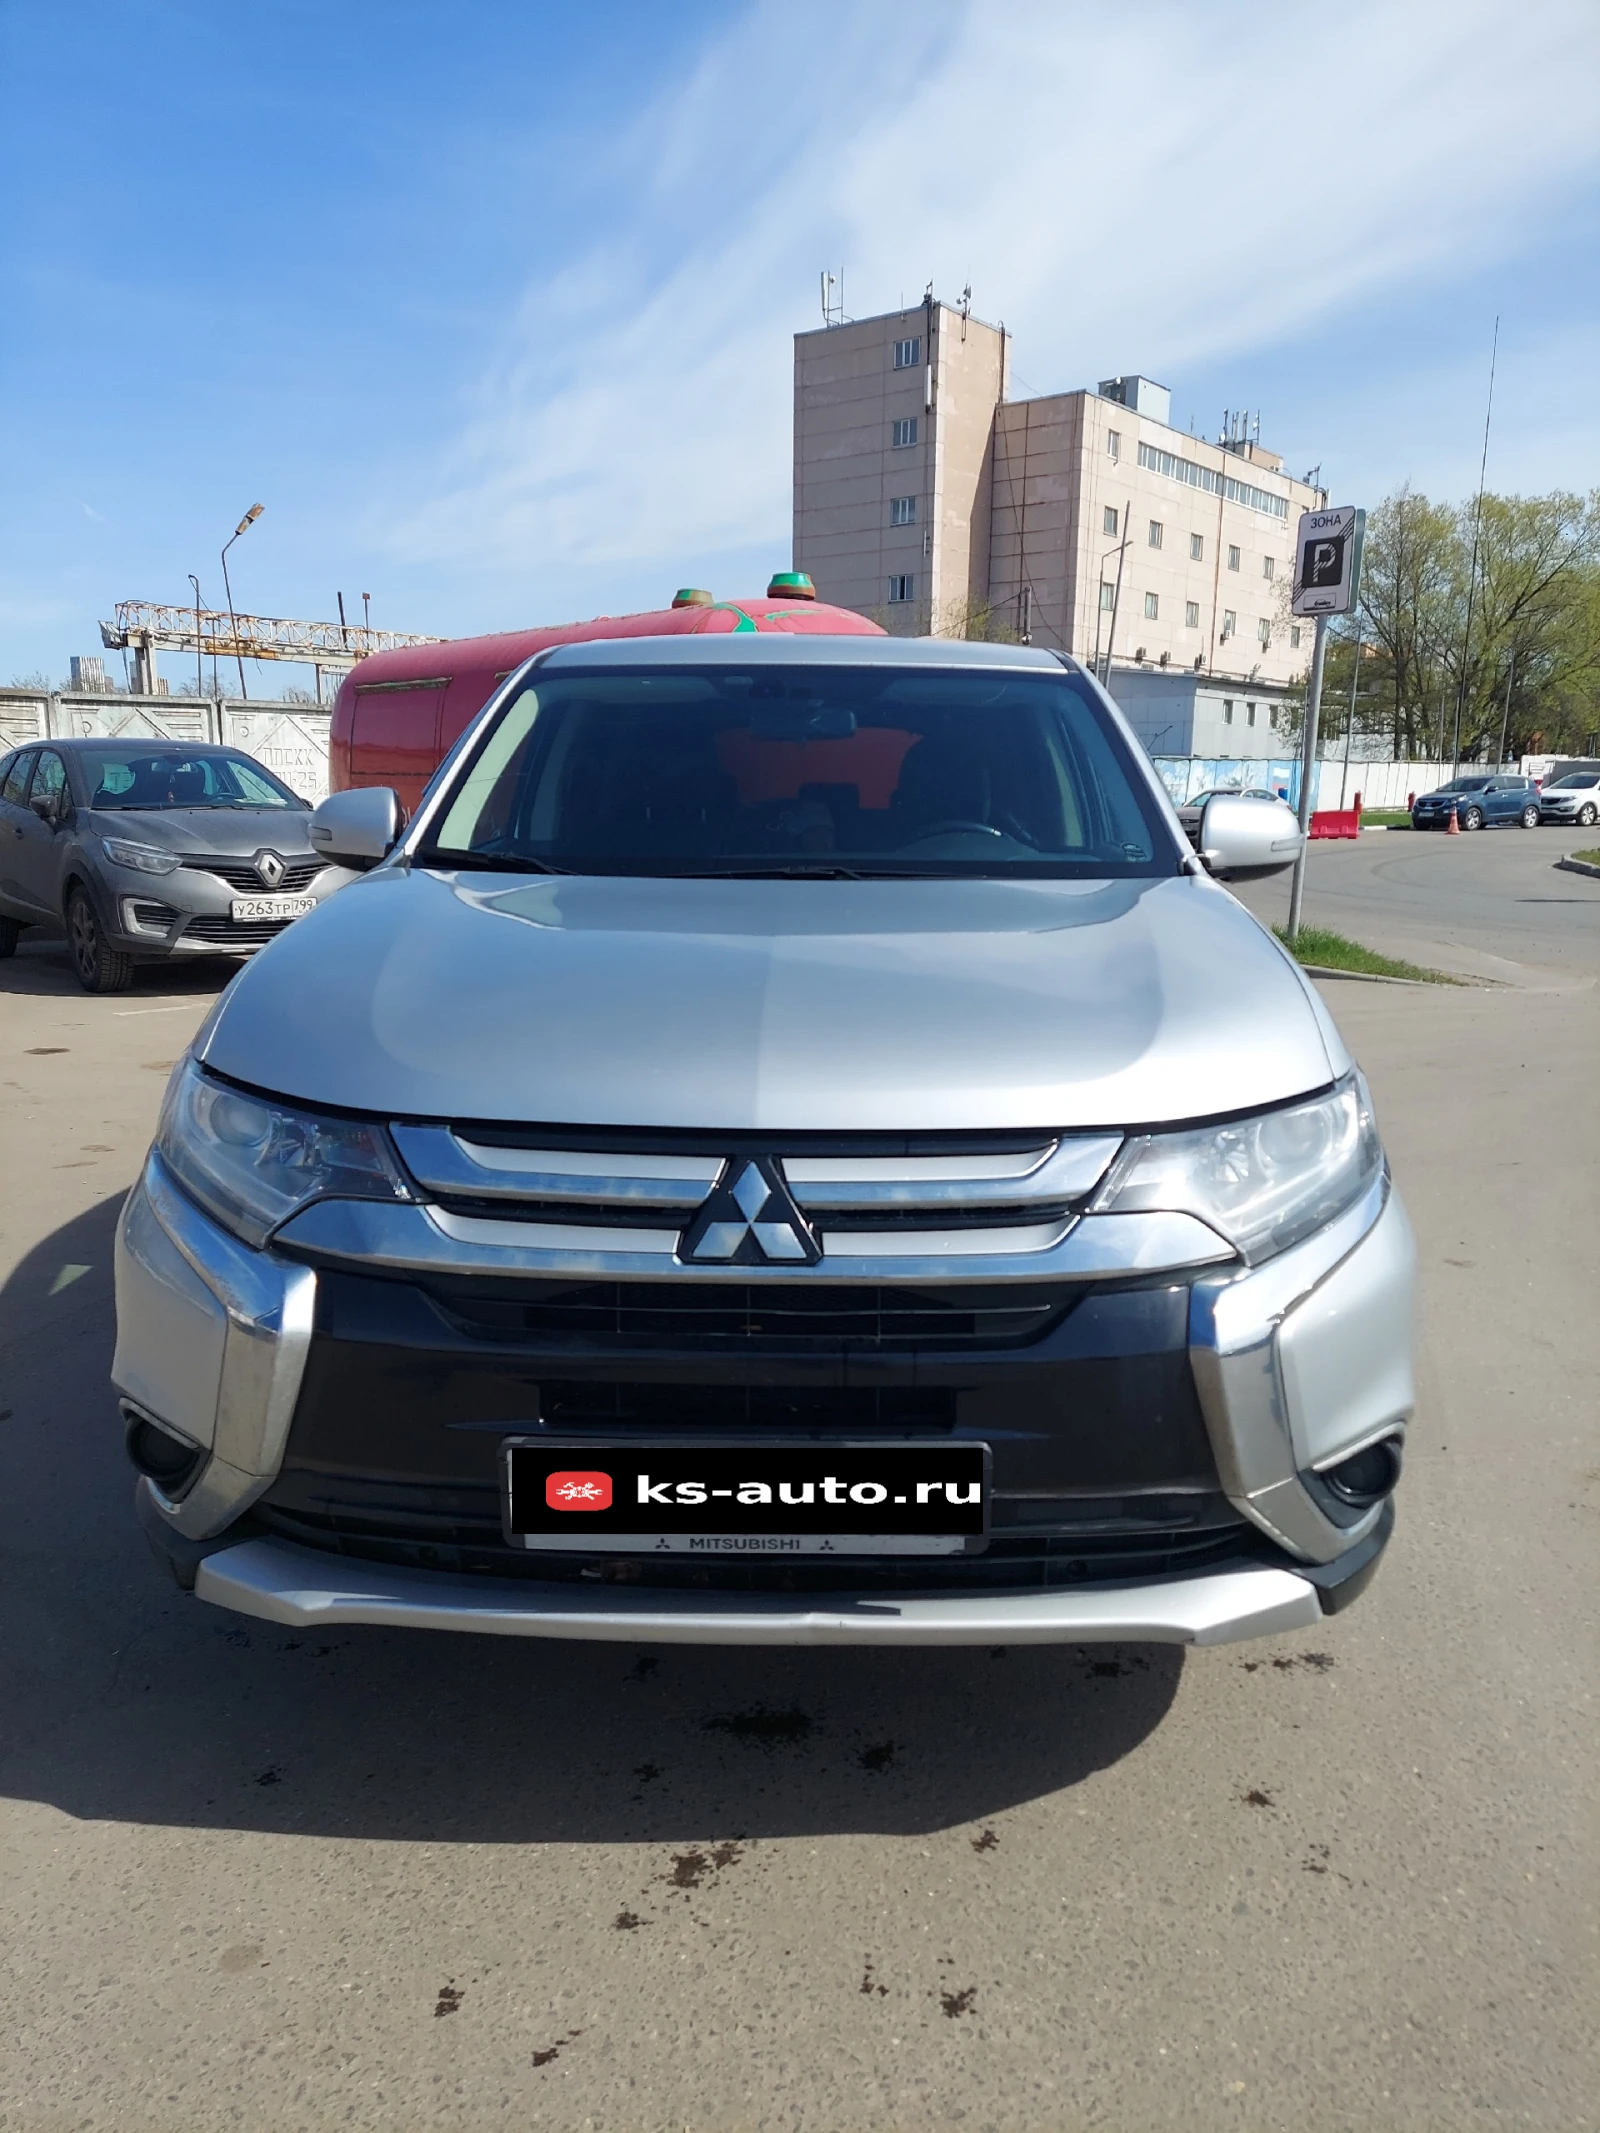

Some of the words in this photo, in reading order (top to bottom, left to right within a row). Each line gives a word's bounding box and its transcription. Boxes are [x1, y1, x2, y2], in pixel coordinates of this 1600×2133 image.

[1310, 514, 1342, 529] ЗОНА
[237, 901, 291, 916] У263ТР
[689, 1538, 800, 1550] MITSUBISHI
